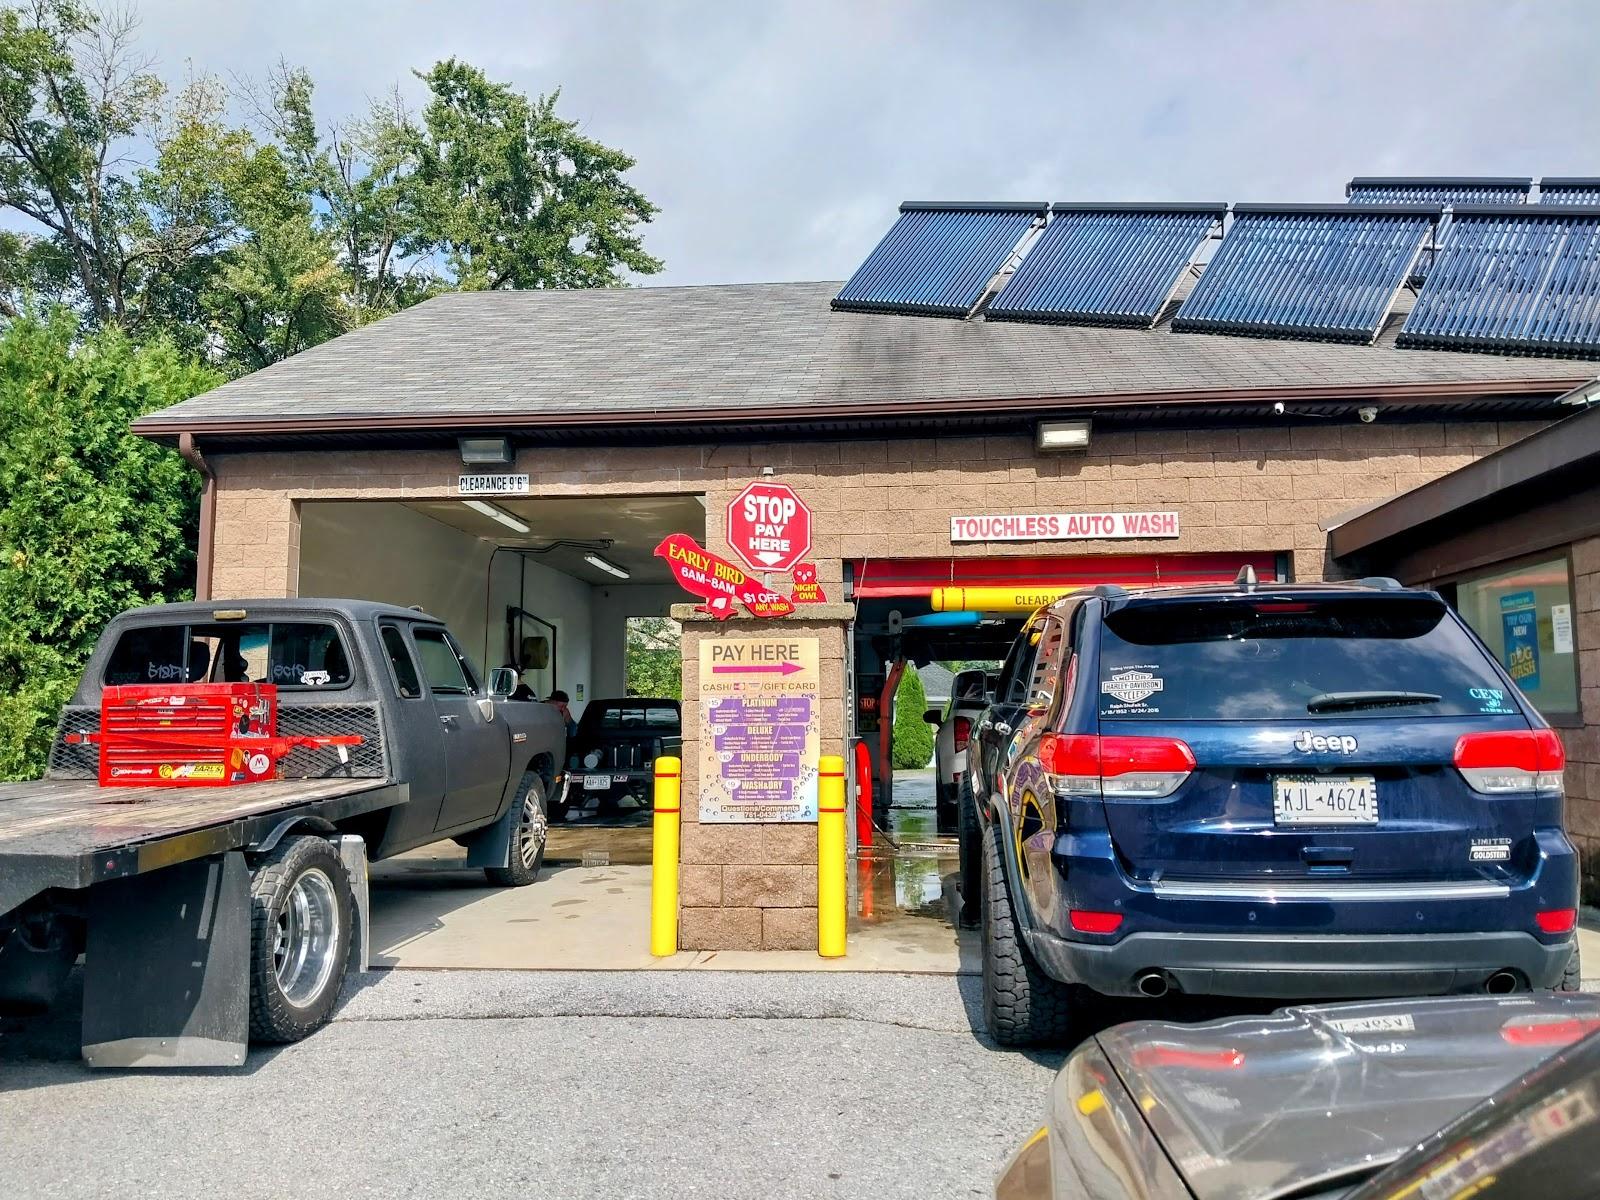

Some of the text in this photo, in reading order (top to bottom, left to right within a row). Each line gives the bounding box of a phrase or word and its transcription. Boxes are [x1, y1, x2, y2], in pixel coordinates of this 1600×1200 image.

[460, 477, 507, 491] CLEARANCE
[744, 494, 796, 524] STOP
[755, 524, 785, 537] PAY
[955, 514, 1175, 538] TOUCHLESS AUTO WASH
[749, 538, 791, 552] HERE
[669, 543, 745, 585] EARLY BIRD
[681, 566, 736, 595] 6AM-8AM
[793, 584, 818, 593] NIGHT
[743, 592, 780, 603] $1 OFF
[798, 592, 818, 600] OWL
[1015, 595, 1062, 605] CLEARA
[755, 602, 789, 612] ANY WASH
[712, 644, 799, 661] PAY HERE
[788, 682, 816, 690] CARD
[742, 699, 778, 708] PLATINUM
[747, 726, 773, 735] DELUXE
[1294, 730, 1358, 757] Jeep
[741, 753, 784, 762] UNDERBODY
[1327, 788, 1366, 811] 4624
[1471, 838, 1512, 846] LIMITED
[1473, 851, 1507, 859] GOLDSTEIN
